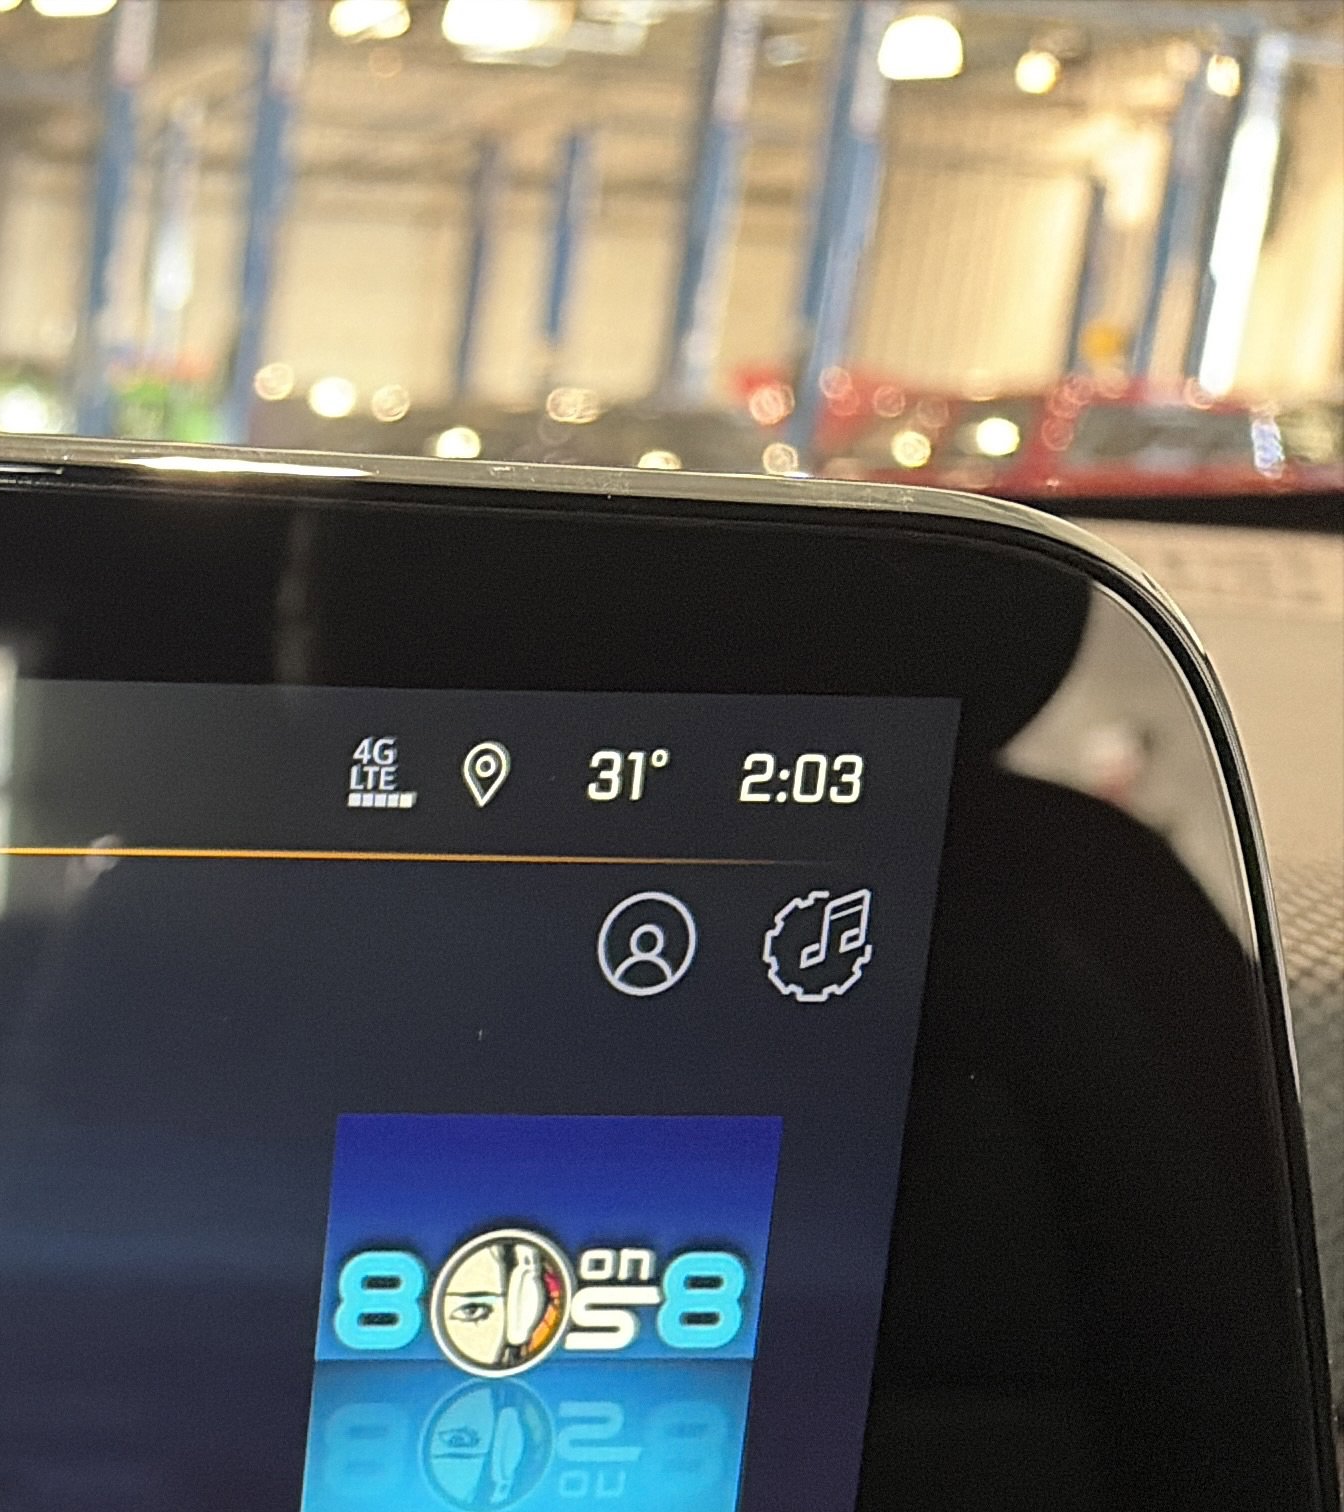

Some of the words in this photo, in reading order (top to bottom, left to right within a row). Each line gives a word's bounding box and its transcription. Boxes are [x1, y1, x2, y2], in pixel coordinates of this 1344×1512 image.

[351, 736, 398, 767] 4G
[348, 764, 398, 792] LTE
[738, 751, 865, 805] 2:03
[579, 1248, 655, 1281] on
[656, 1251, 747, 1349] 8
